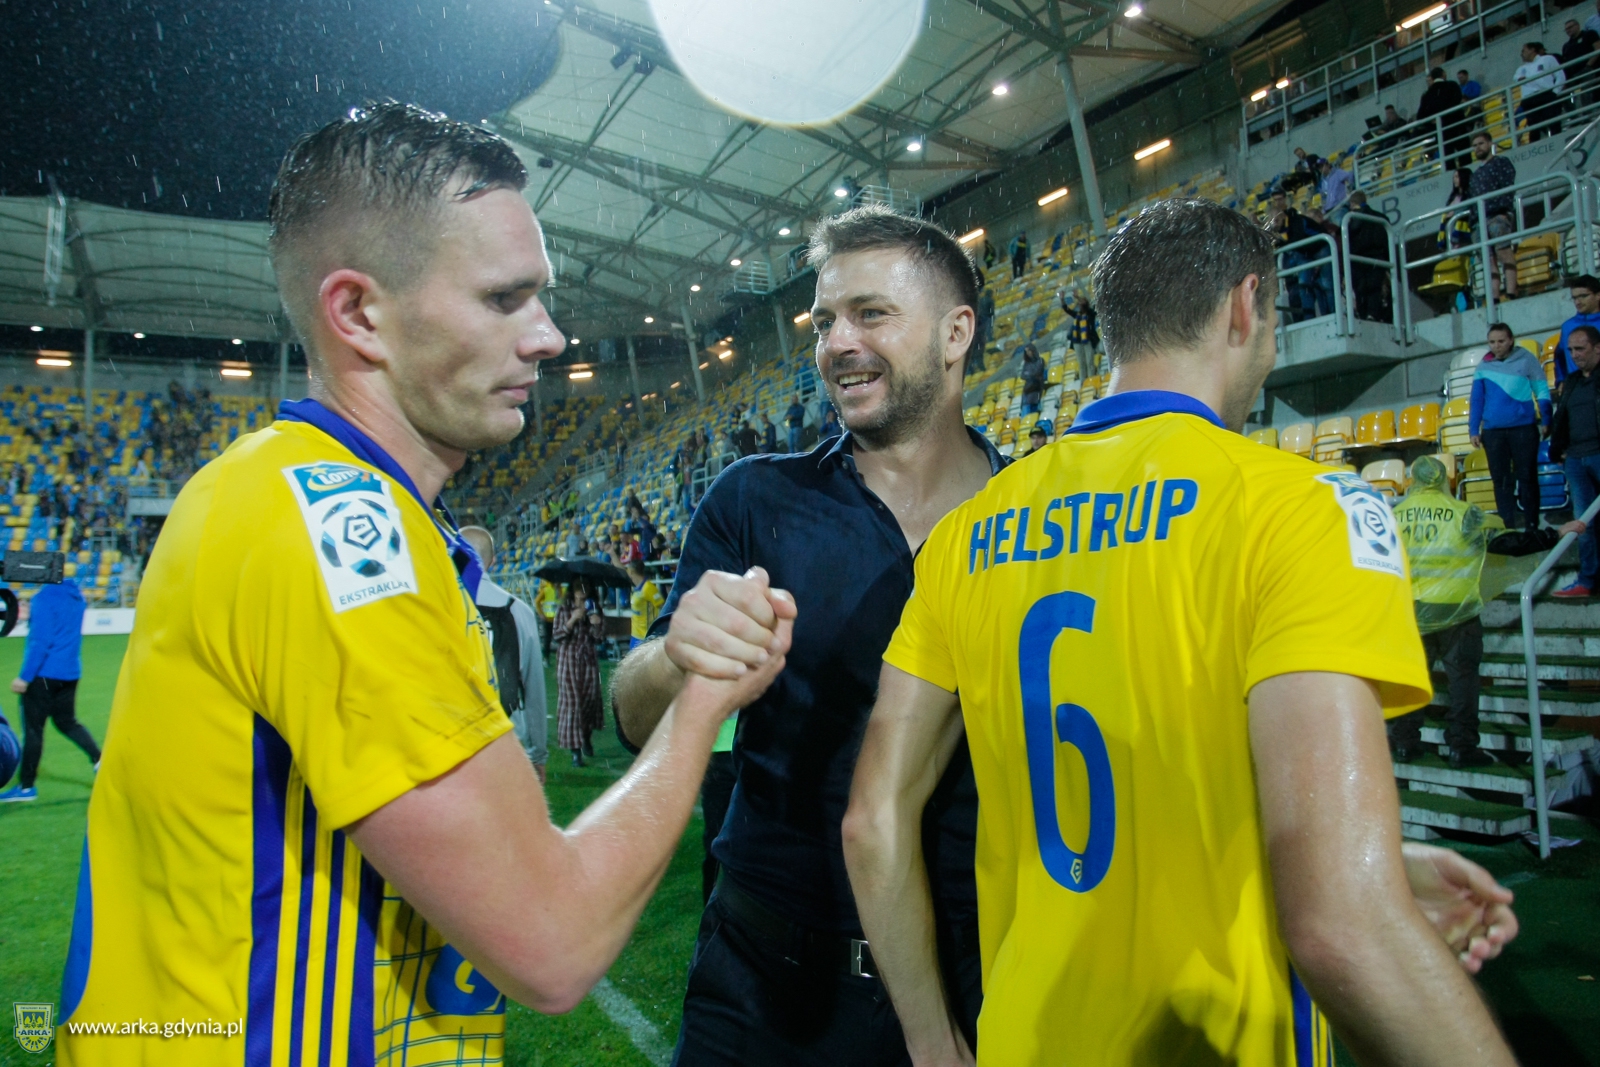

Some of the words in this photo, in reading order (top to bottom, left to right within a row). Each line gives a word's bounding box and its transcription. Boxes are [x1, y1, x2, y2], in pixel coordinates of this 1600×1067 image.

[1511, 142, 1556, 163] WEJŚCIE
[1405, 181, 1440, 198] SEKTOR
[1381, 196, 1402, 226] B
[317, 470, 360, 485] LOTTO
[1395, 507, 1454, 523] TEWARD
[968, 478, 1199, 575] HELSTRUP
[1018, 590, 1117, 894] 6
